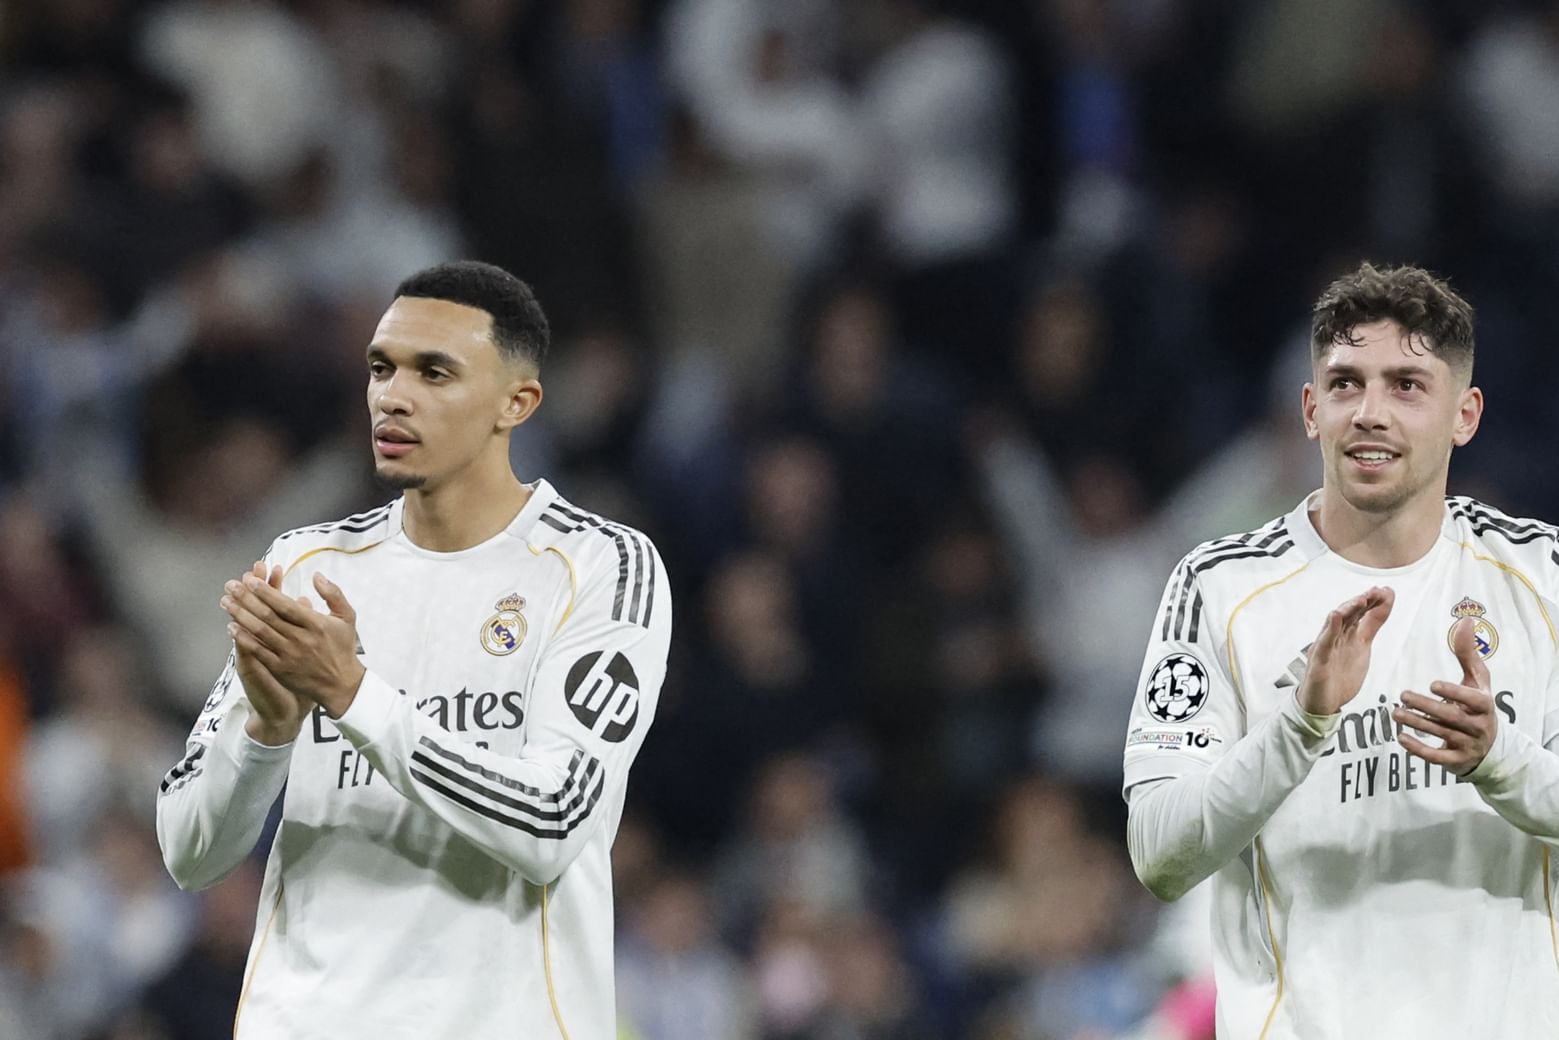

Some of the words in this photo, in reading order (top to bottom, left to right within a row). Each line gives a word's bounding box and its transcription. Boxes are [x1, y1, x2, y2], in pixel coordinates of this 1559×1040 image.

[566, 650, 640, 743] hp
[1160, 674, 1190, 702] 15
[1340, 756, 1379, 804] FLY
